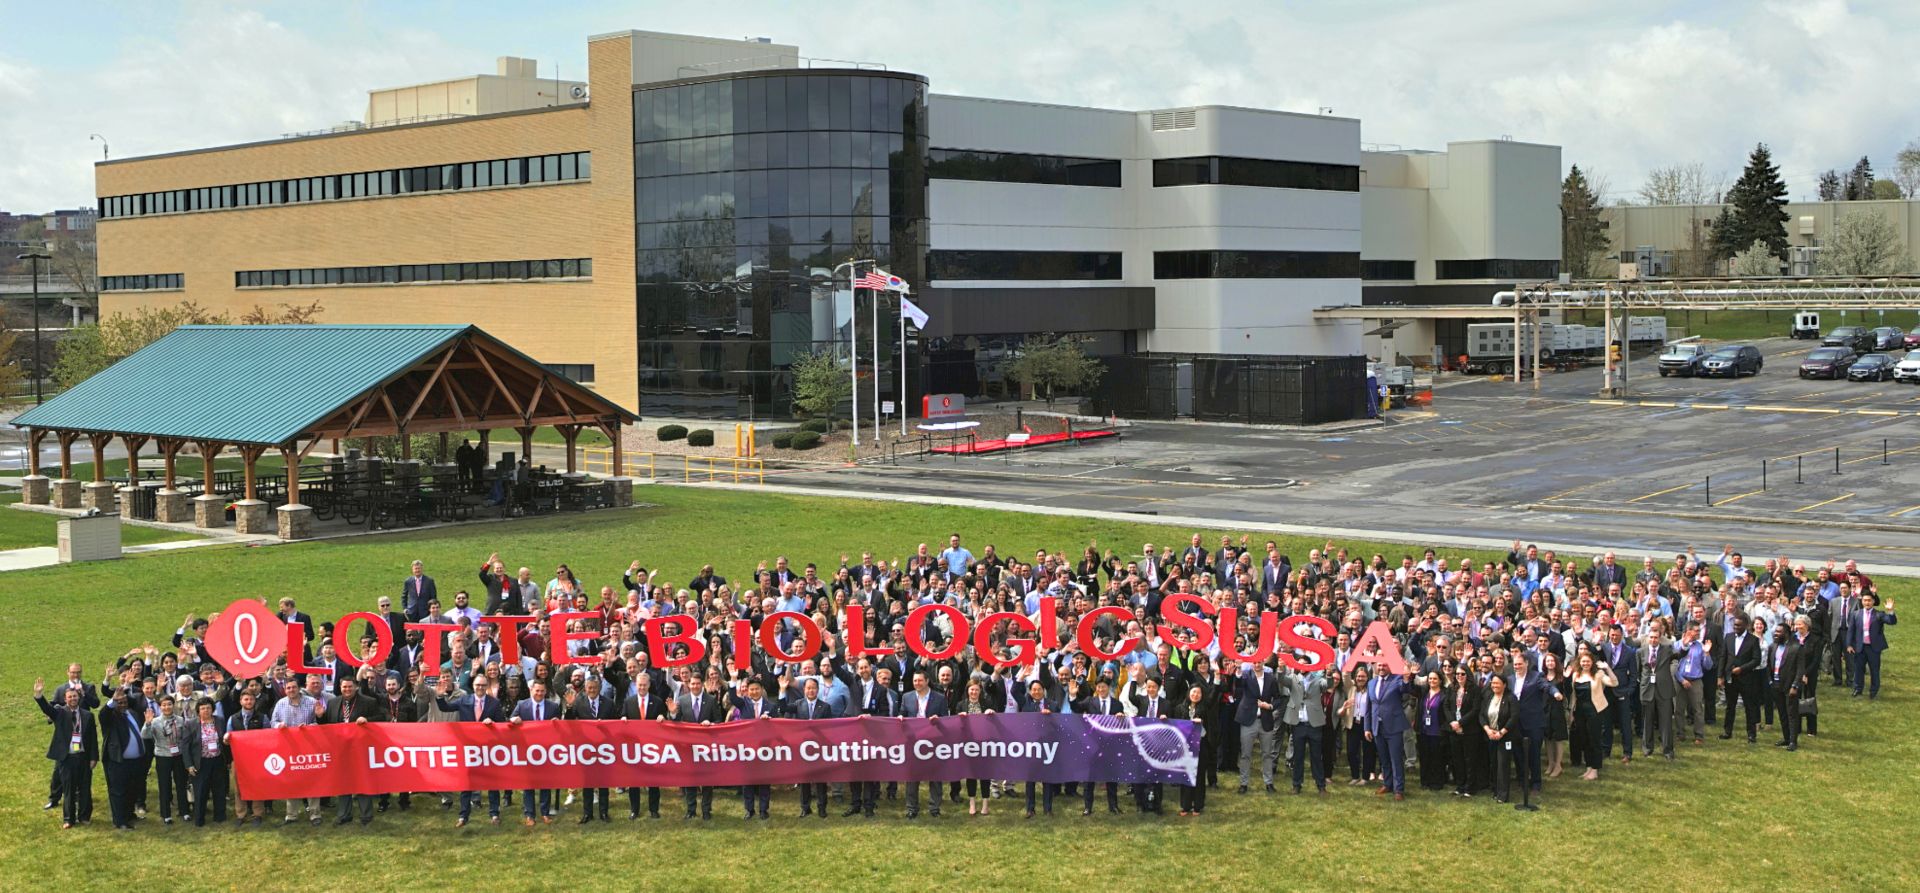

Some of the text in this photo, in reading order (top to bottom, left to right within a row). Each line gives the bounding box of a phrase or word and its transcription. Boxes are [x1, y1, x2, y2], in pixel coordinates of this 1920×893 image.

[287, 592, 1409, 677] LOTTE BIOLOGICS USA
[289, 753, 332, 764] LOTTE
[368, 739, 1059, 768] LOTTE BIOLOGICS USA Ribbon Cutting Ceremony
[290, 763, 327, 771] BIOLOGICS
